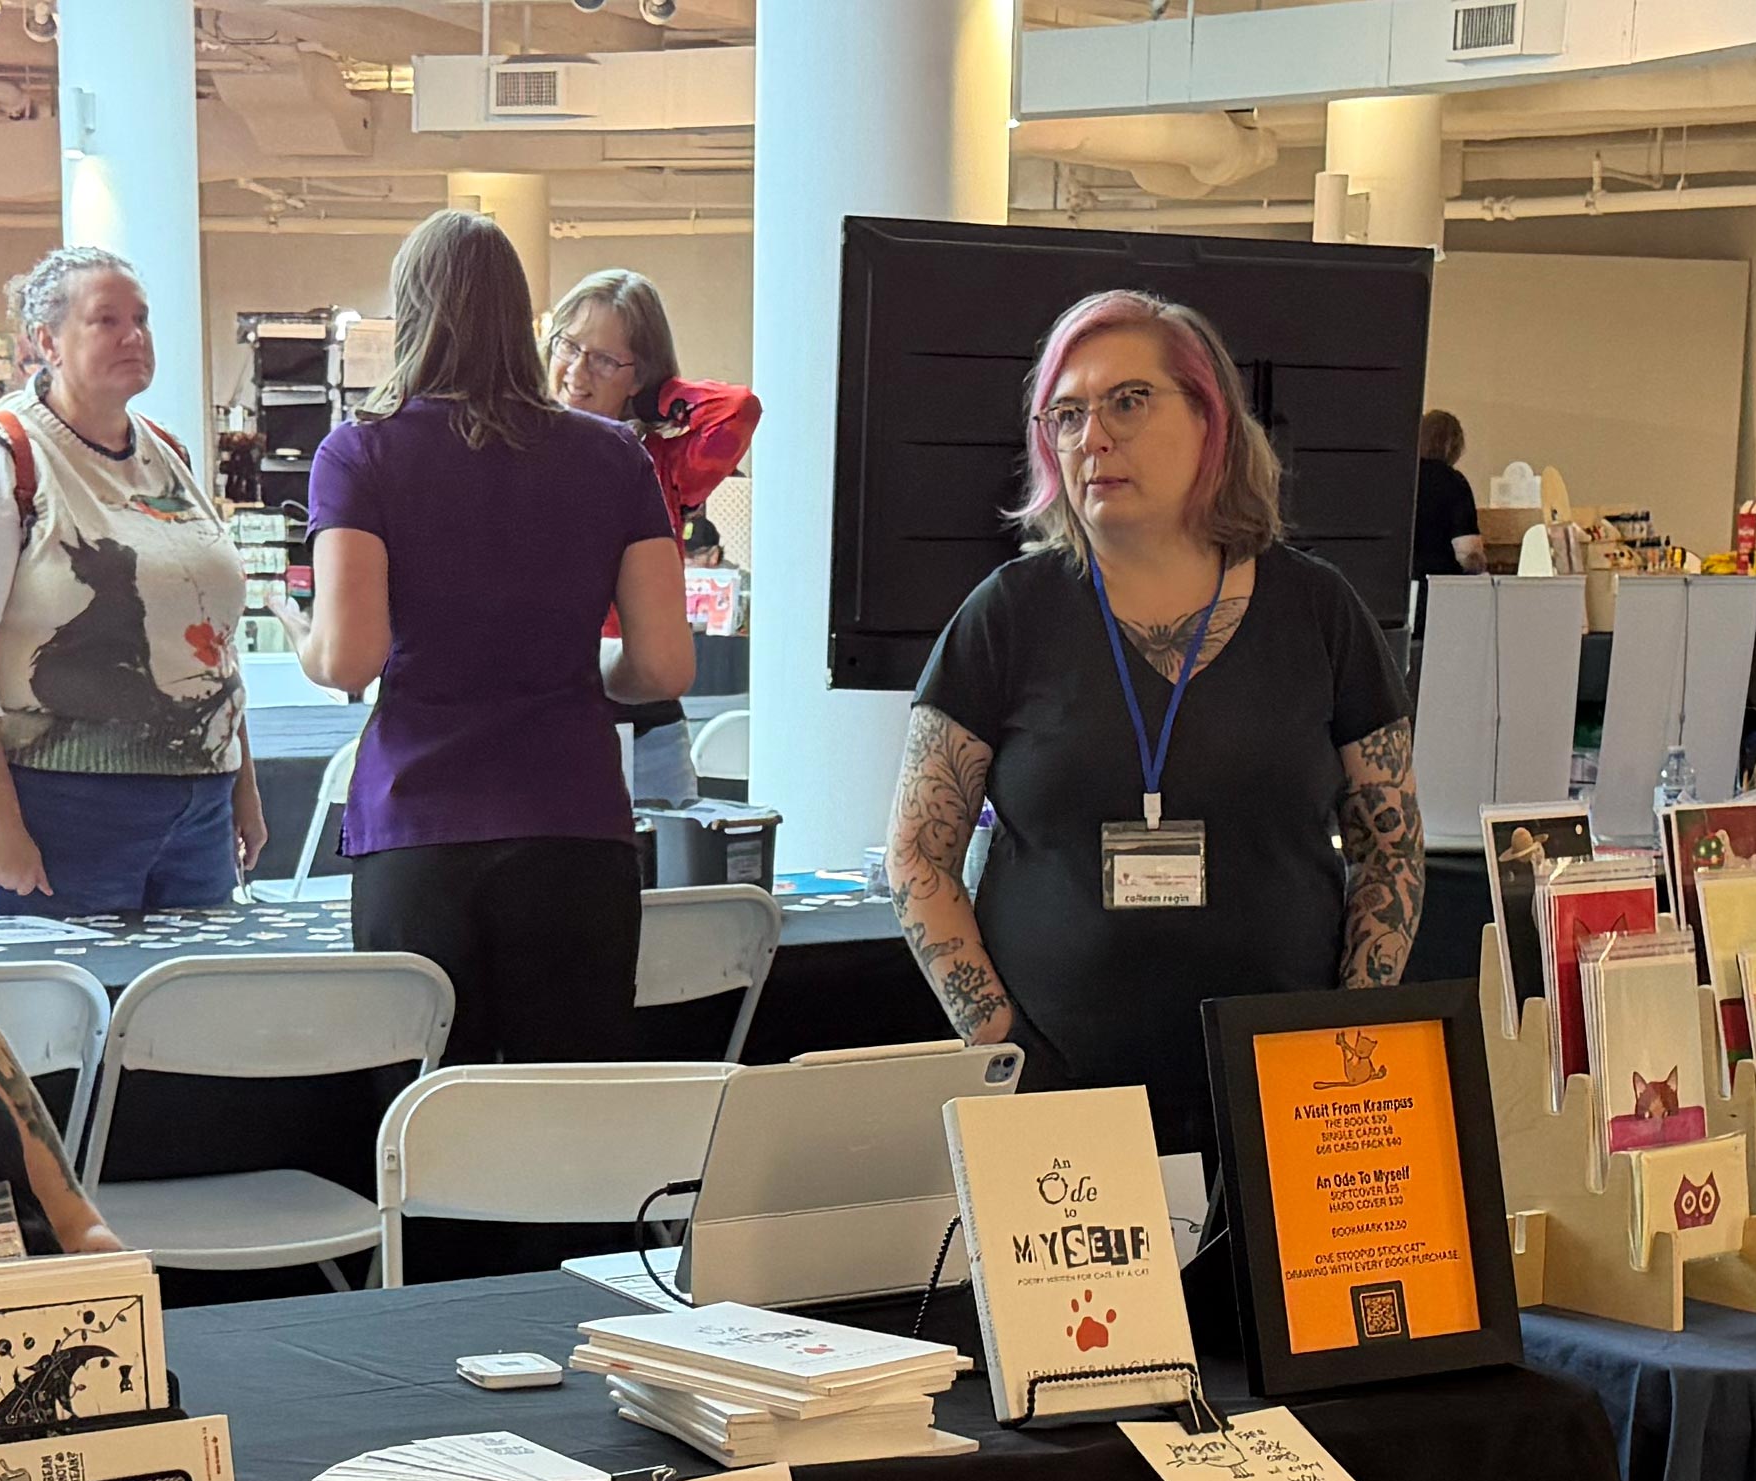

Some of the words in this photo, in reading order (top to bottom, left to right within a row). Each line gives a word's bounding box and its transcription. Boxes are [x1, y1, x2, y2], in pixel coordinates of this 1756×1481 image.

[1294, 1106, 1302, 1120] A
[1303, 1104, 1329, 1118] Visit
[1332, 1102, 1361, 1116] From
[1364, 1097, 1413, 1113] Krampus
[1325, 1119, 1341, 1128] THE
[1344, 1116, 1370, 1127] BOOK
[1052, 1157, 1071, 1170] An
[1316, 1176, 1331, 1190] An
[1334, 1172, 1356, 1188] Ode
[1358, 1171, 1370, 1184] To
[1374, 1165, 1409, 1187] Myself
[1037, 1172, 1098, 1204] Ode
[1356, 1197, 1386, 1210] COVER
[1064, 1207, 1077, 1218] to
[1332, 1222, 1383, 1238] BOOKMARK
[1012, 1224, 1150, 1268] MYSELF
[1315, 1253, 1334, 1264] ONE
[1331, 1262, 1353, 1275] WITH
[1355, 1259, 1383, 1272] EVERY
[1385, 1255, 1410, 1268] BOOK
